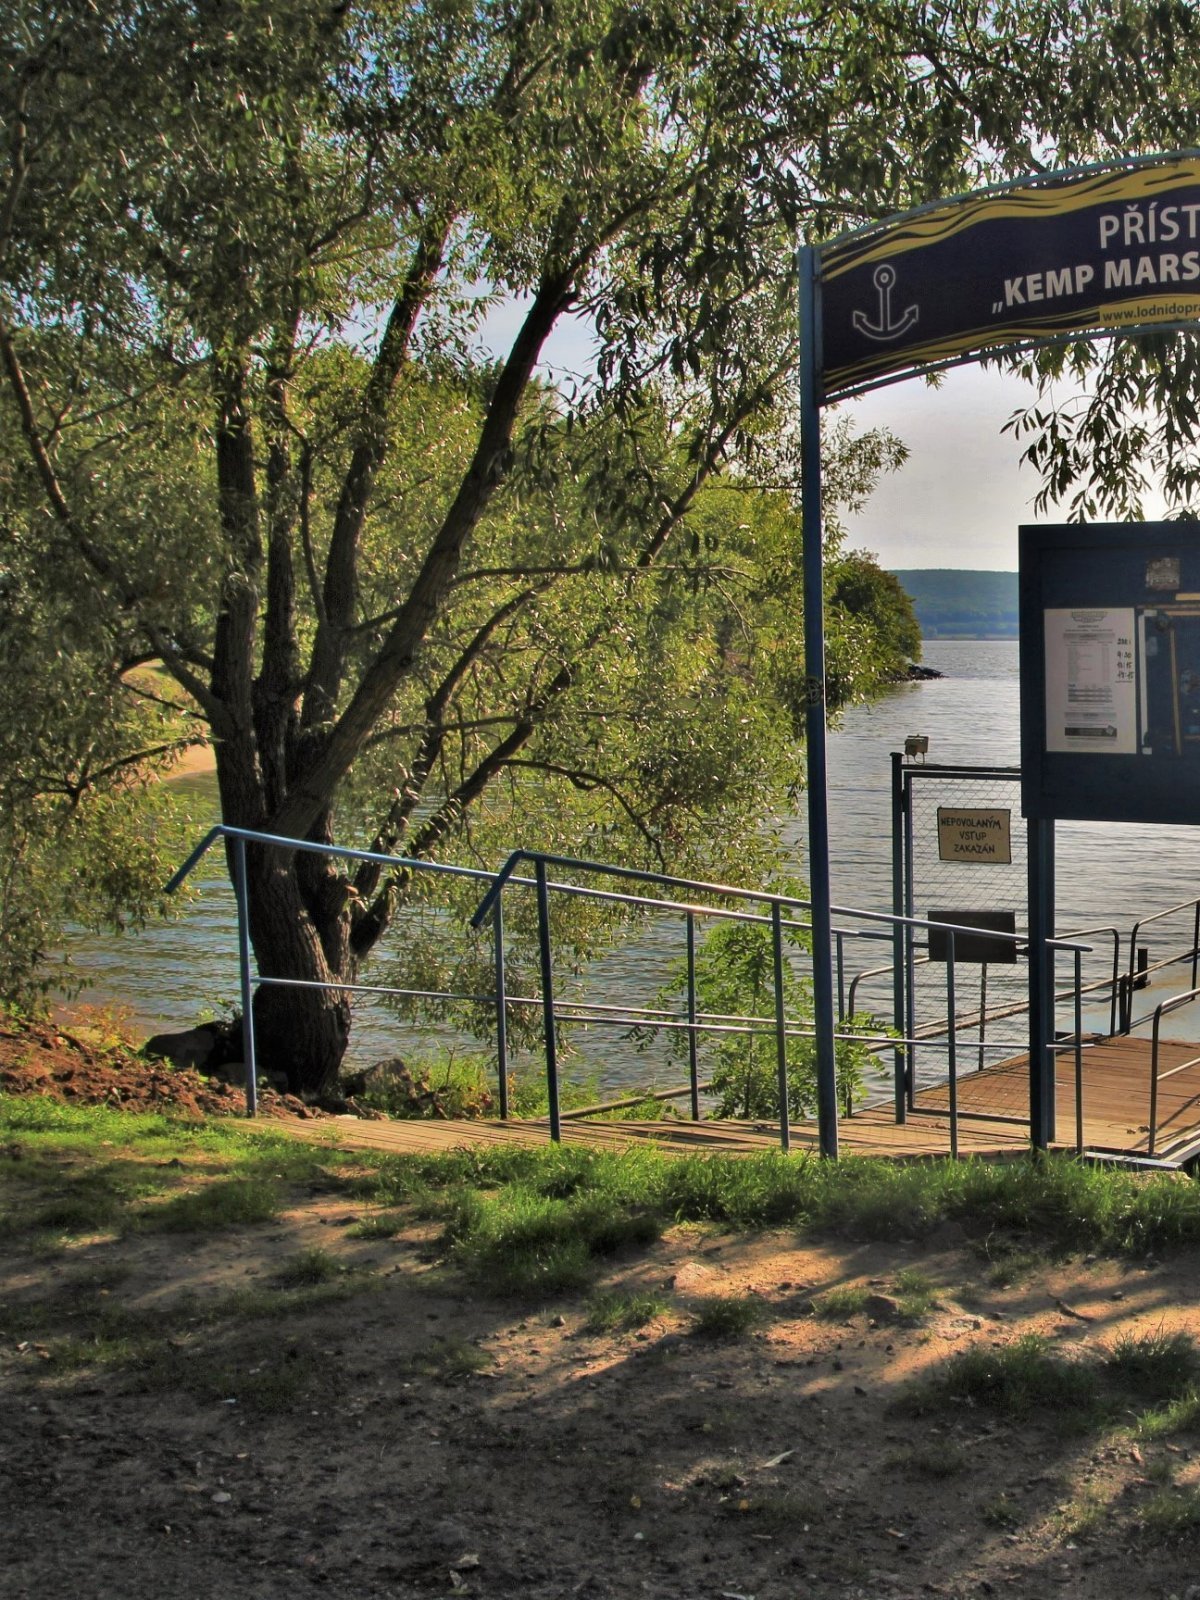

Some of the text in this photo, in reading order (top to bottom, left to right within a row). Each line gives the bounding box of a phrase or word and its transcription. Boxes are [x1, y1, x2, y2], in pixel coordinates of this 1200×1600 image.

[1104, 251, 1200, 289] MARS
[941, 816, 1002, 830] NEPOVOLANÝM
[959, 831, 987, 840] VSTUP
[954, 843, 995, 854] ZAKAZÁN
